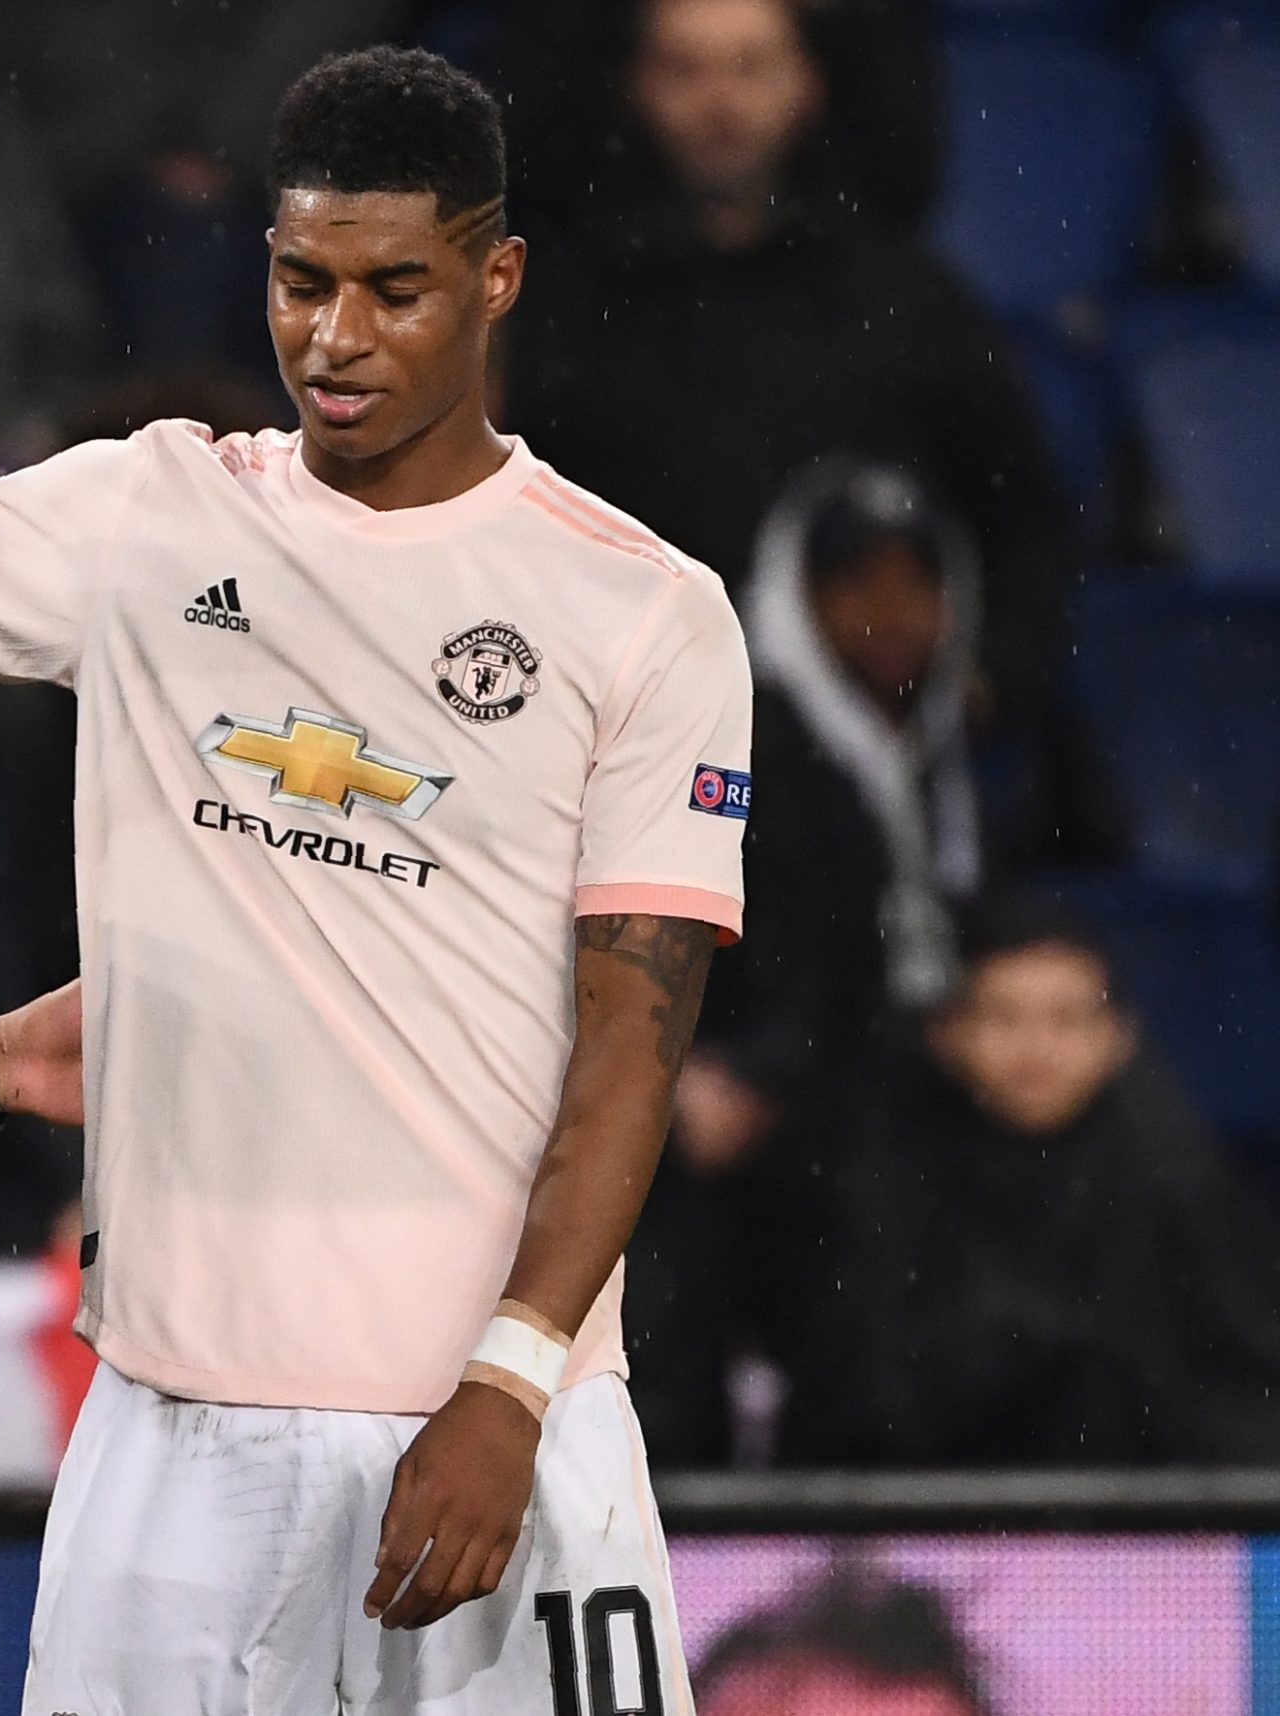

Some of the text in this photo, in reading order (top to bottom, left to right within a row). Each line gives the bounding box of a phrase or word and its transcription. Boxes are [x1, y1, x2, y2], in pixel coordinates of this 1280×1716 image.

[184, 605, 251, 633] adidas
[449, 628, 534, 670] MANCHESTER
[449, 694, 509, 719] UNITED
[193, 798, 441, 888] CHEVROLET
[534, 1585, 665, 1716] 10
